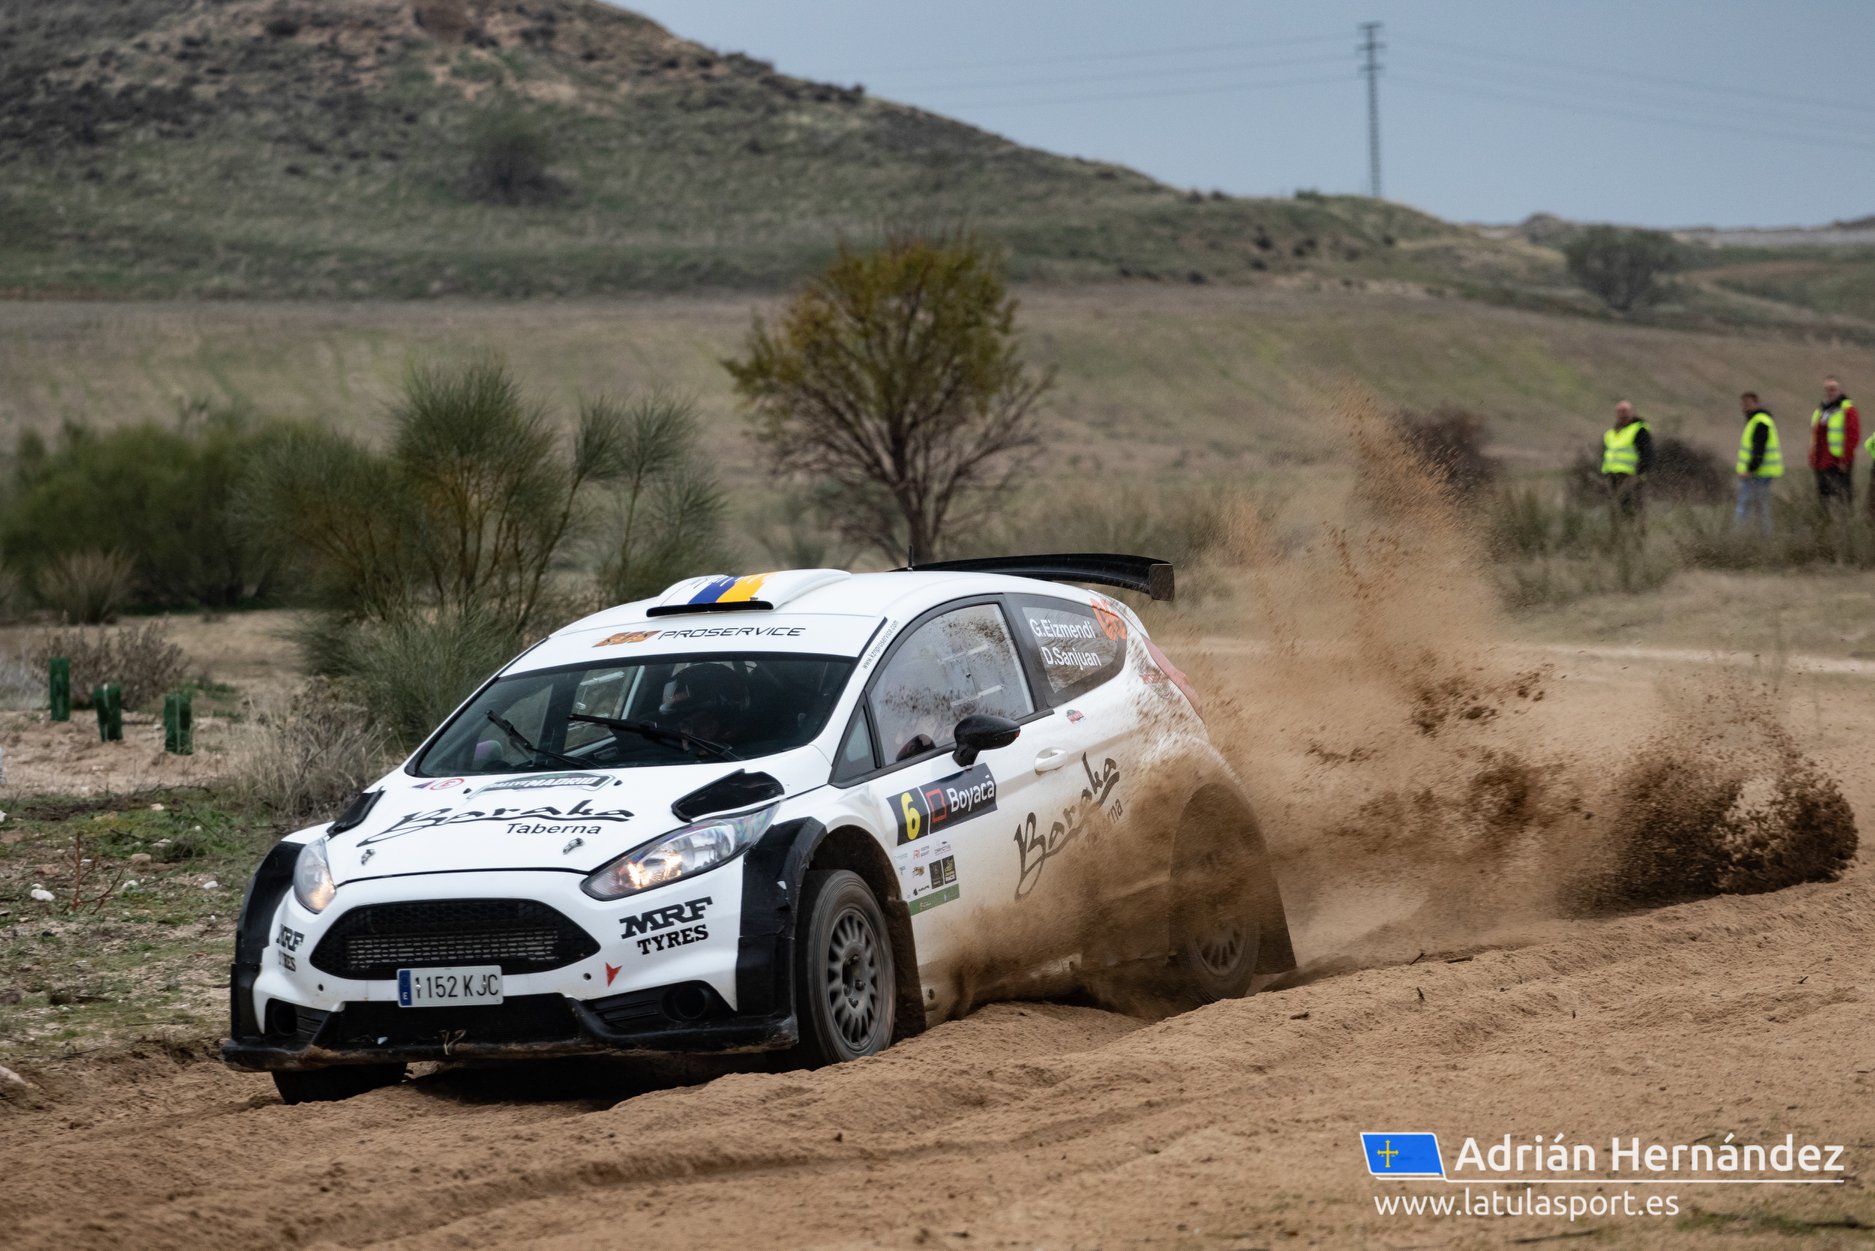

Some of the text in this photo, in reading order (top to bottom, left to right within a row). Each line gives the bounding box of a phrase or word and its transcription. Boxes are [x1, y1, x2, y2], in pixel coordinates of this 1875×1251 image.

[658, 627, 806, 640] PROSERVICE
[1029, 618, 1096, 640] G.Eizmendi
[1041, 646, 1102, 671] D.Sanjuan
[524, 776, 600, 788] MADRID
[901, 774, 995, 840] 6 Boyacá
[506, 822, 602, 835] Taberna
[618, 896, 713, 939] MRF
[637, 924, 709, 955] TYRES
[415, 973, 499, 999] 1152 KJC
